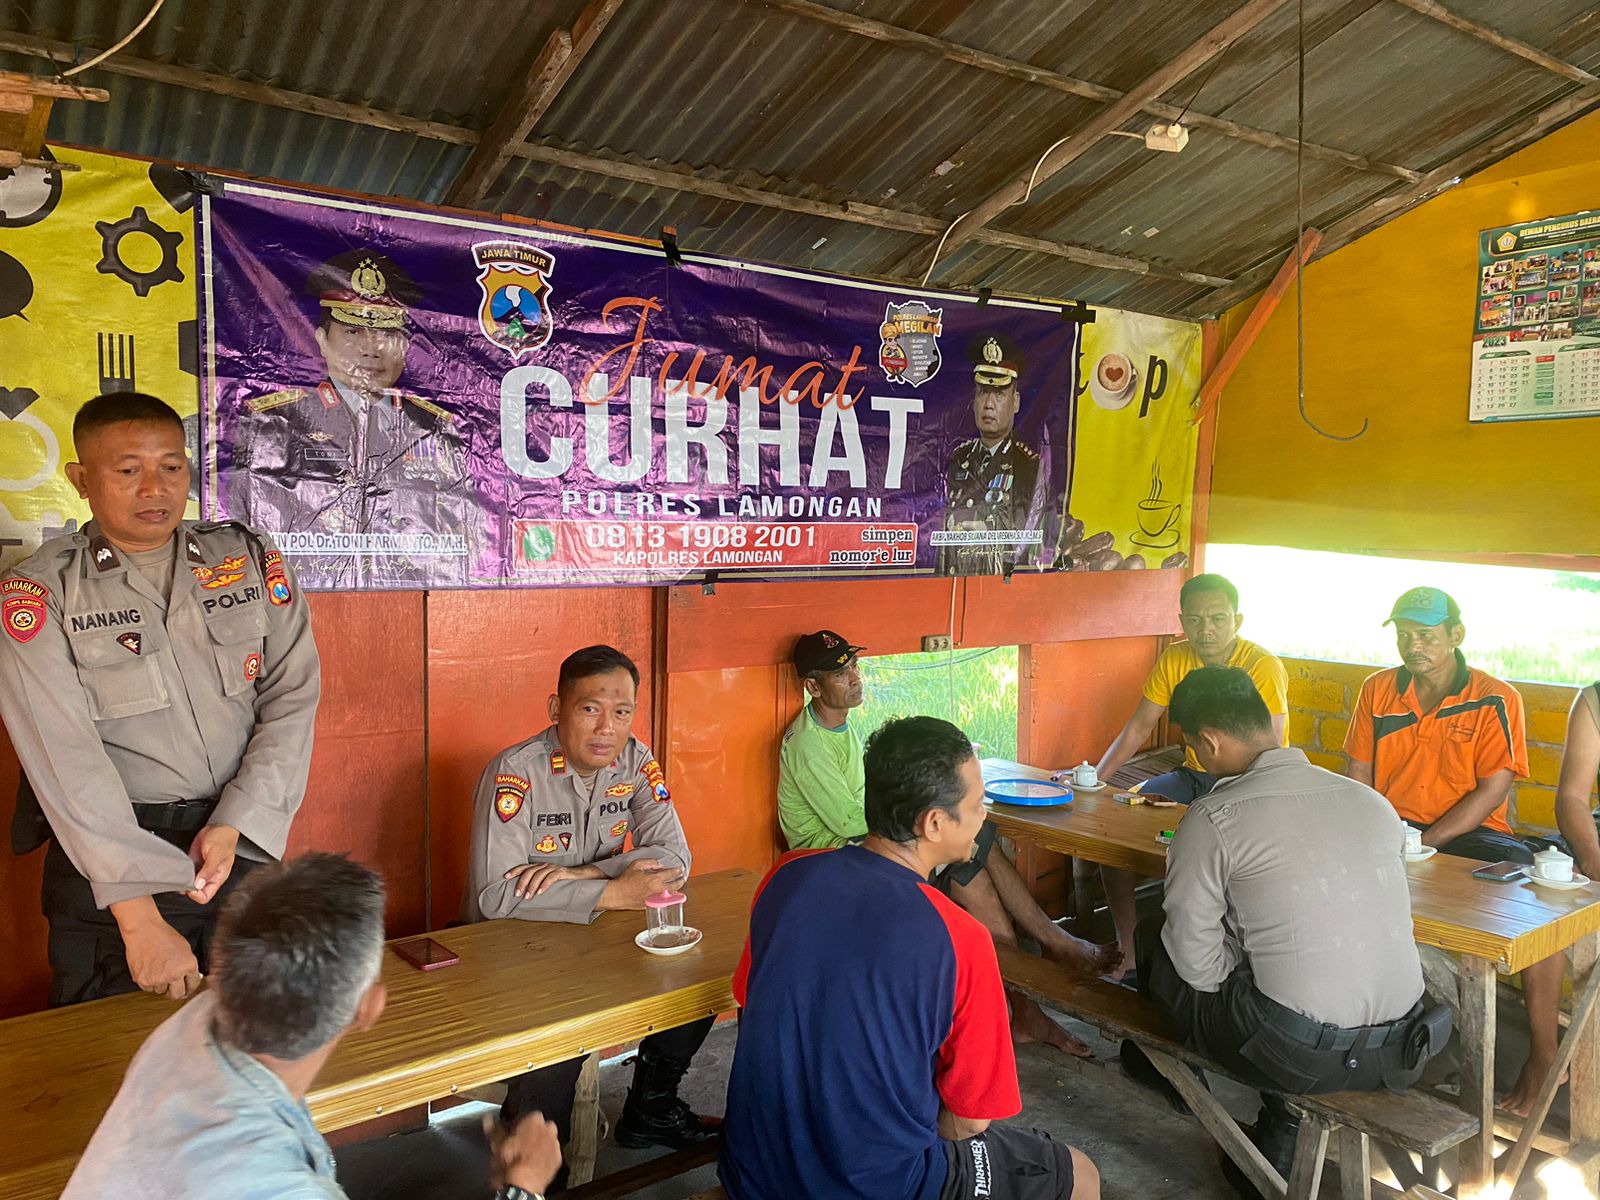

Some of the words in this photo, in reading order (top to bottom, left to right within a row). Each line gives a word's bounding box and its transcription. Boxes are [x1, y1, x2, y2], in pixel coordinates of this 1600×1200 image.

[481, 248, 511, 259] JAWA
[513, 250, 546, 267] TIMUR
[1482, 336, 1507, 348] 2023
[579, 296, 868, 410] Jumat
[500, 365, 925, 490] CURHAT
[562, 490, 701, 517] POLRES
[719, 496, 882, 519] LAMONGAN
[586, 524, 666, 549] 0813
[679, 525, 748, 549] 1908
[755, 525, 816, 548] 2001
[861, 528, 914, 545] simpen
[613, 551, 699, 566] KAPOLRES
[702, 549, 783, 565] LAMONGAN
[829, 549, 886, 564] nomor'e
[891, 548, 912, 563] lur
[4, 581, 44, 598] BAHARKAM
[202, 586, 262, 614] POLRI
[71, 609, 142, 632] NANANG
[600, 801, 630, 817] POL
[970, 1140, 991, 1196] THRASHER
